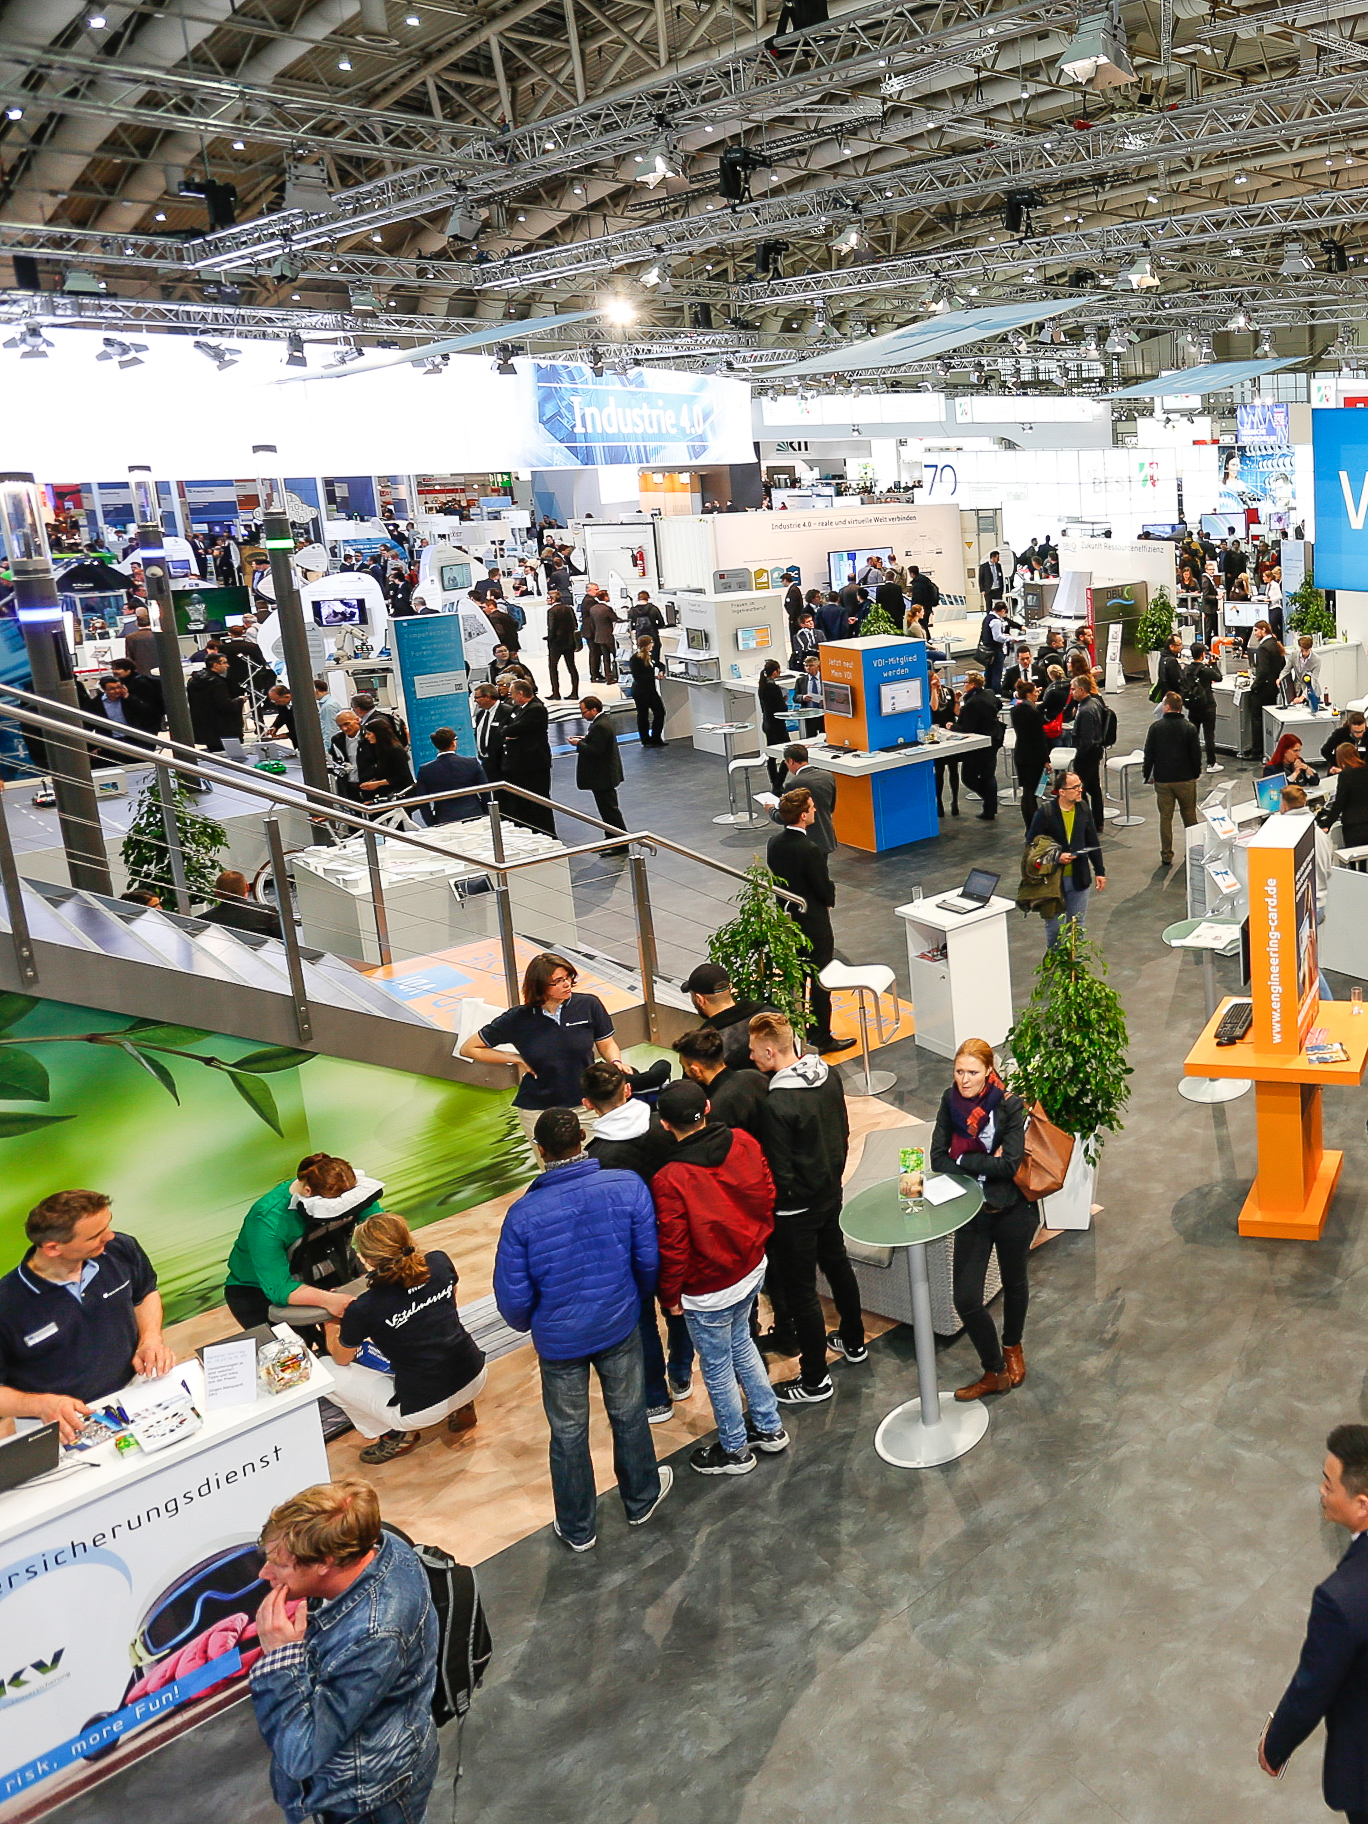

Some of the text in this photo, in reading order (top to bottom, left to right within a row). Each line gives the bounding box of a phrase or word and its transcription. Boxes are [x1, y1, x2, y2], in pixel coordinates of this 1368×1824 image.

[569, 395, 704, 435] Industrie 4.0
[924, 463, 958, 496] 70
[771, 514, 917, 531] Industrie 4.0 reale und virtuelle Welt verbinden
[1081, 541, 1164, 553] Zukunft Ressourceneffizienz
[872, 653, 918, 668] VDI-Mitglied
[882, 667, 909, 678] werden
[1265, 878, 1283, 1044] www.engineering-card.de
[6, 1685, 181, 1794] risk, more Fun!
